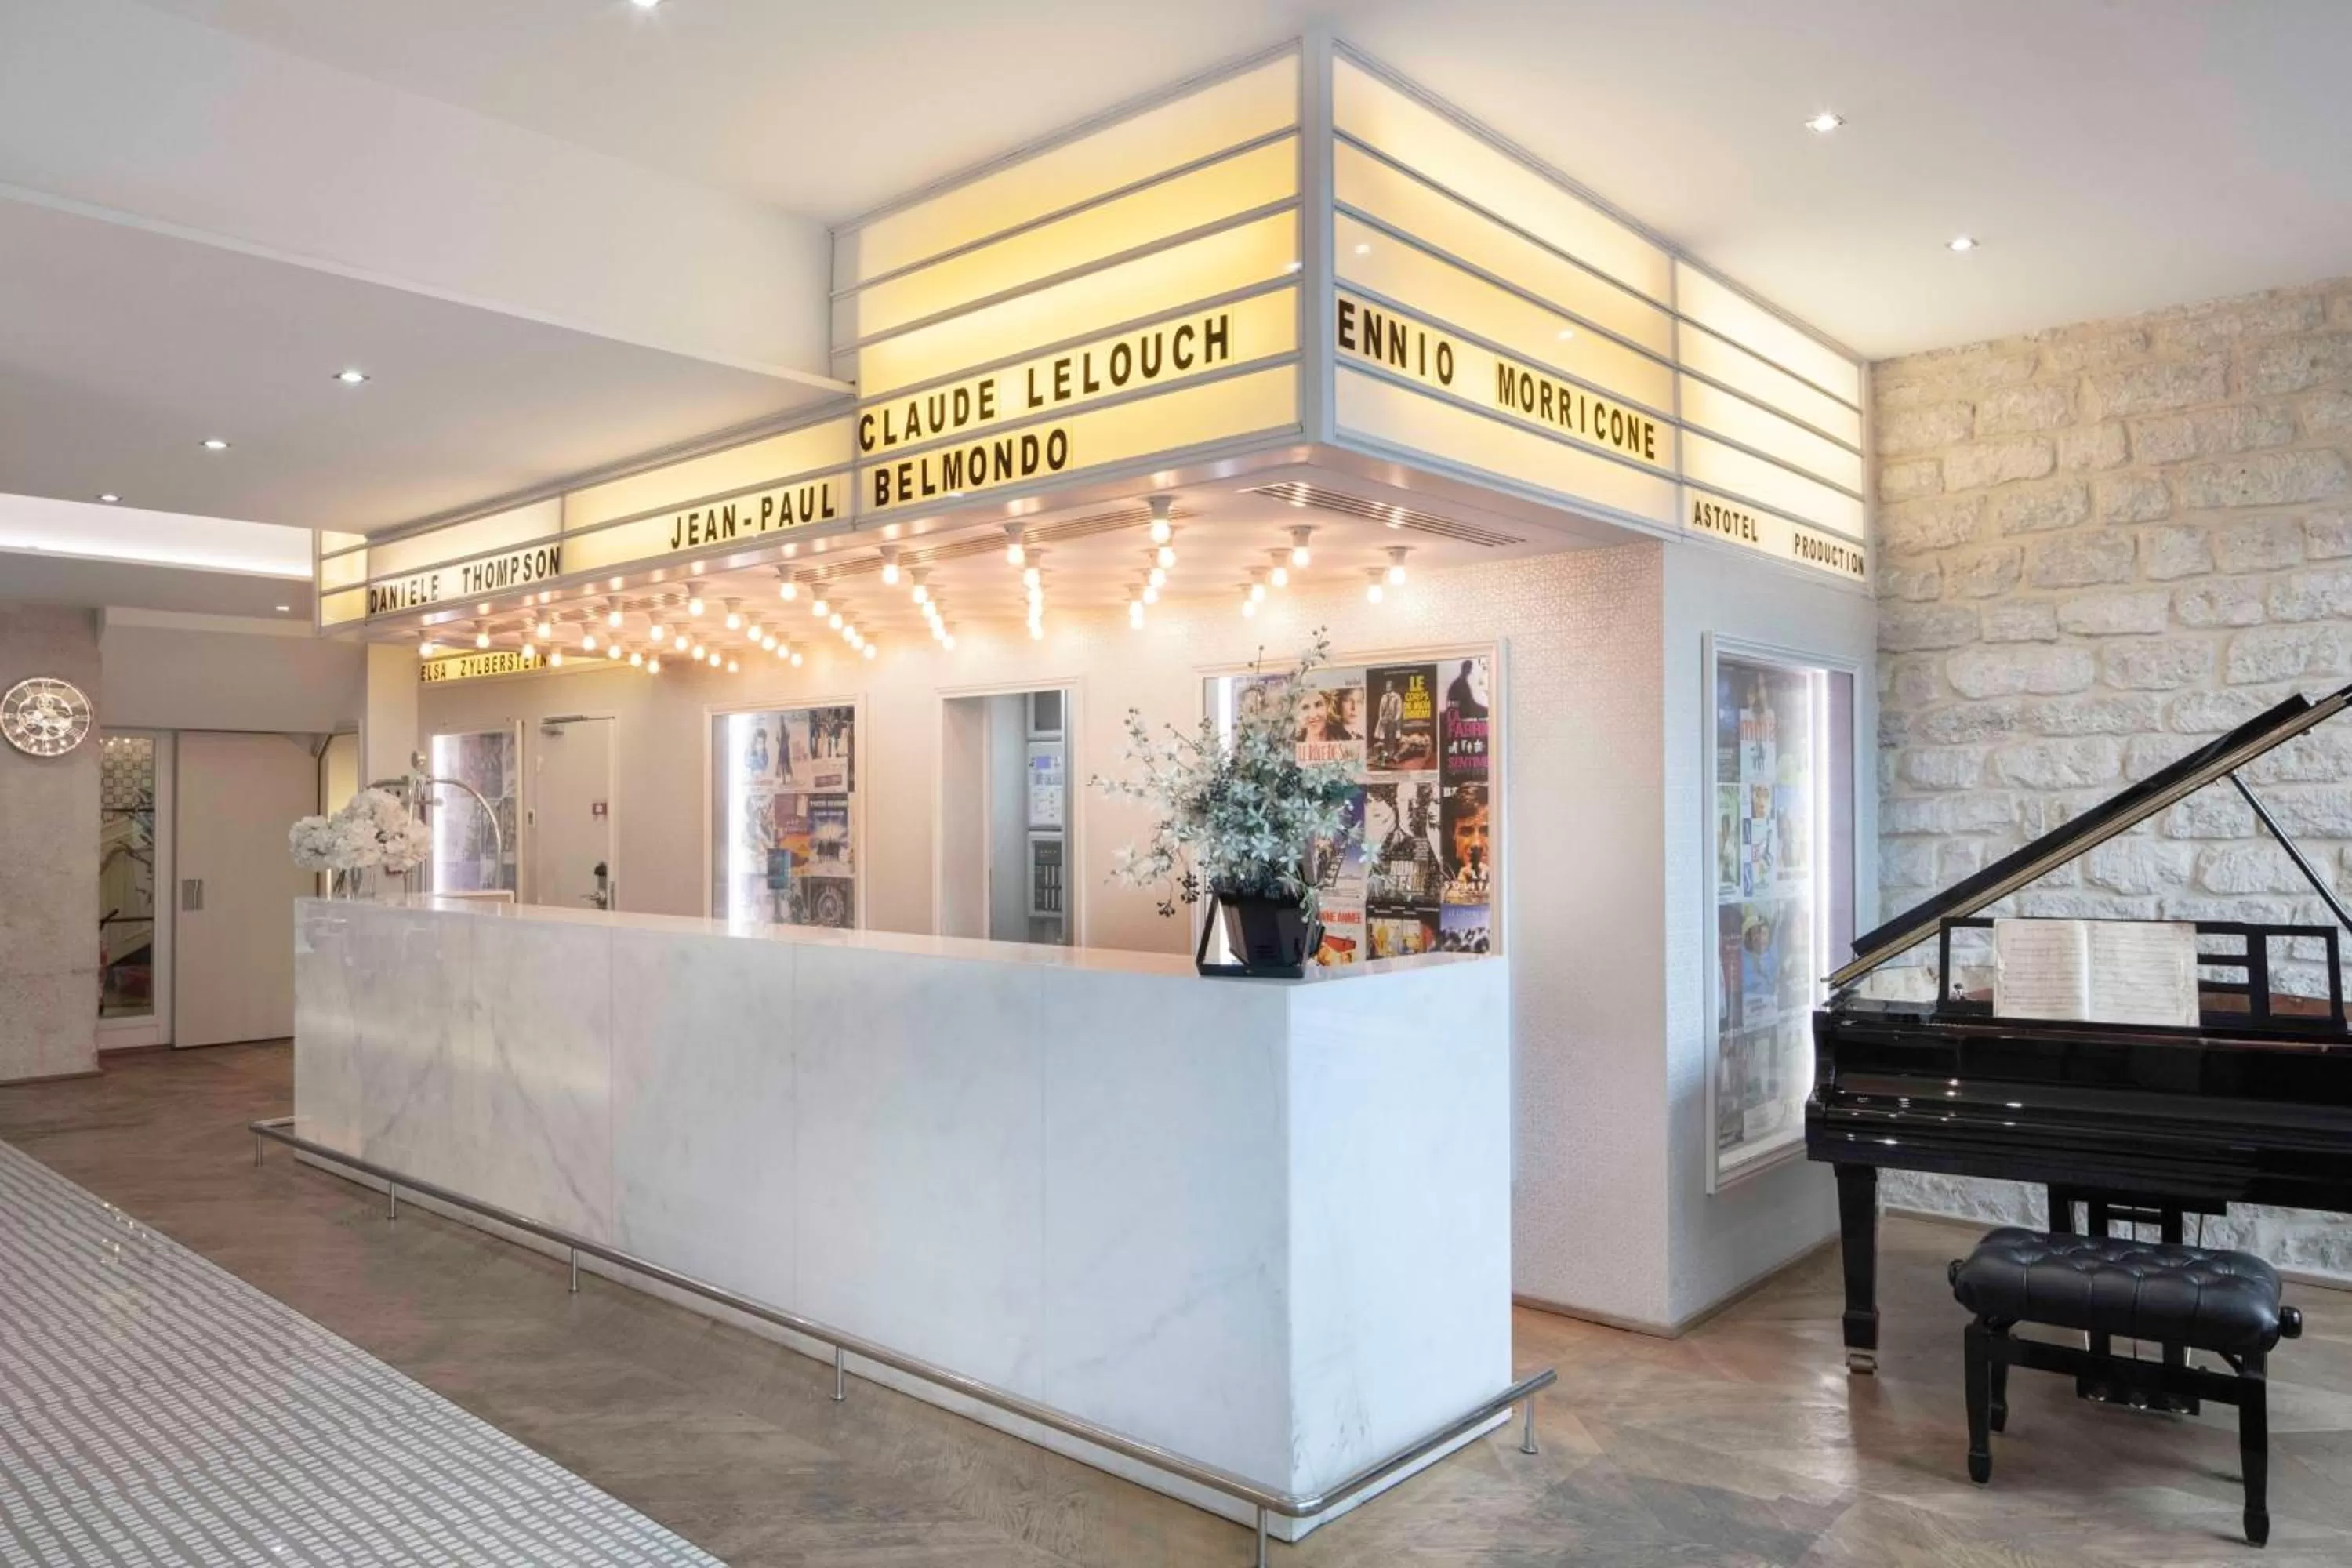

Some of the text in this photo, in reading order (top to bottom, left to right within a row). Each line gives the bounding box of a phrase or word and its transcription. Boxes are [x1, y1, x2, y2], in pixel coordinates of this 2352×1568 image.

[858, 314, 1229, 452] CLAUDE LELOUCH
[1338, 299, 1656, 461] ENNIO MORRICONE
[670, 428, 1068, 550] JEAN-PAUL BELMONDO
[1693, 499, 1865, 575] ASTOTEL PRODUCTION
[370, 546, 561, 614] DANIELE THOMPSON
[420, 662, 446, 681] ELSA
